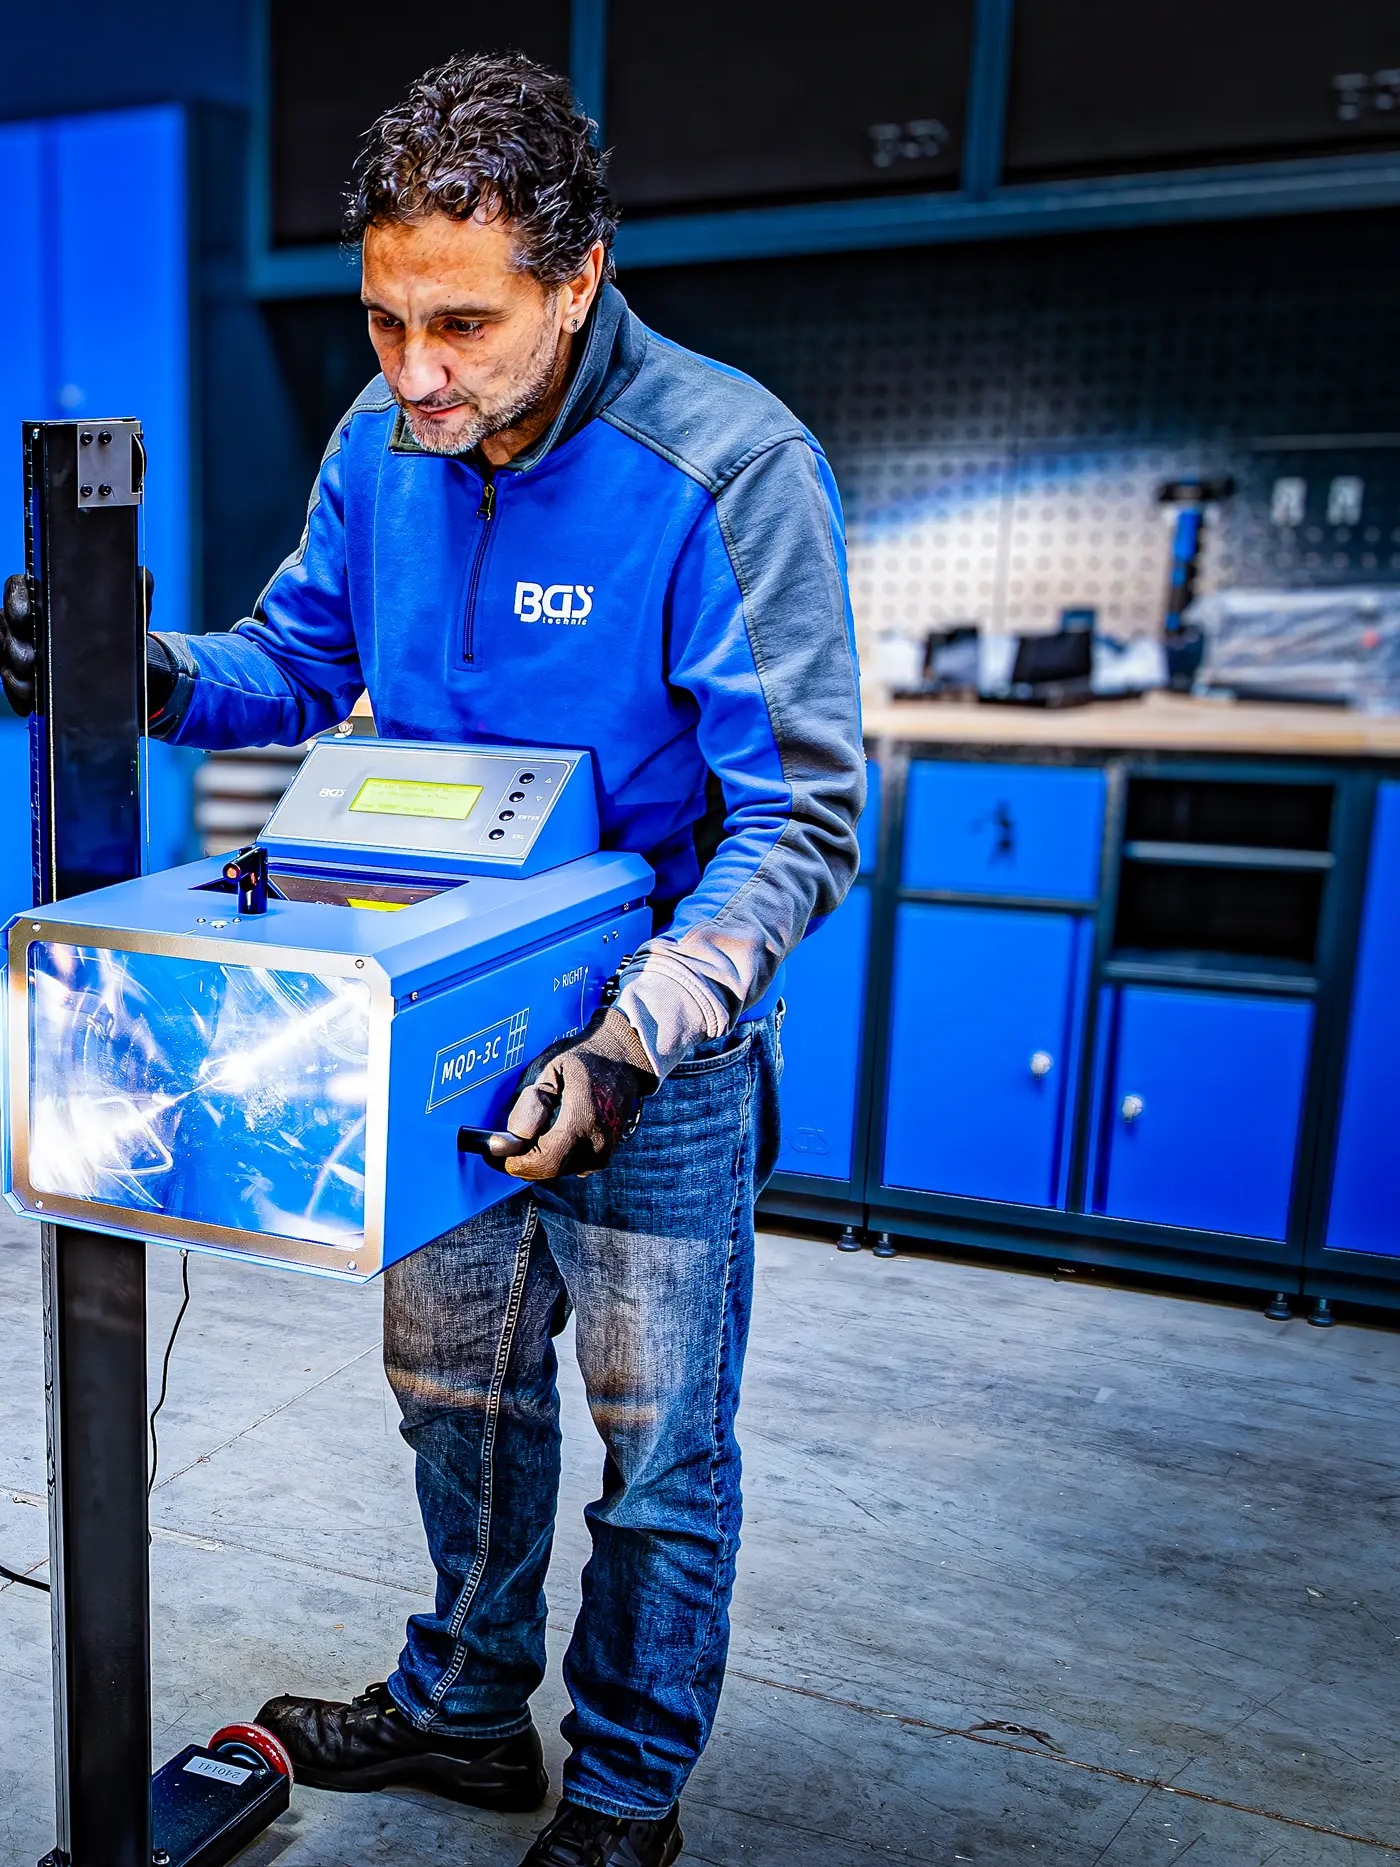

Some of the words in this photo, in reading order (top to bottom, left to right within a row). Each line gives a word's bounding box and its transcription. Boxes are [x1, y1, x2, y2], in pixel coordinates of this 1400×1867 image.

[514, 581, 594, 623] BGS
[542, 616, 588, 626] technic
[562, 966, 583, 988] RIGHT
[441, 1036, 501, 1085] MQD-3C
[198, 1762, 242, 1779] 240141
